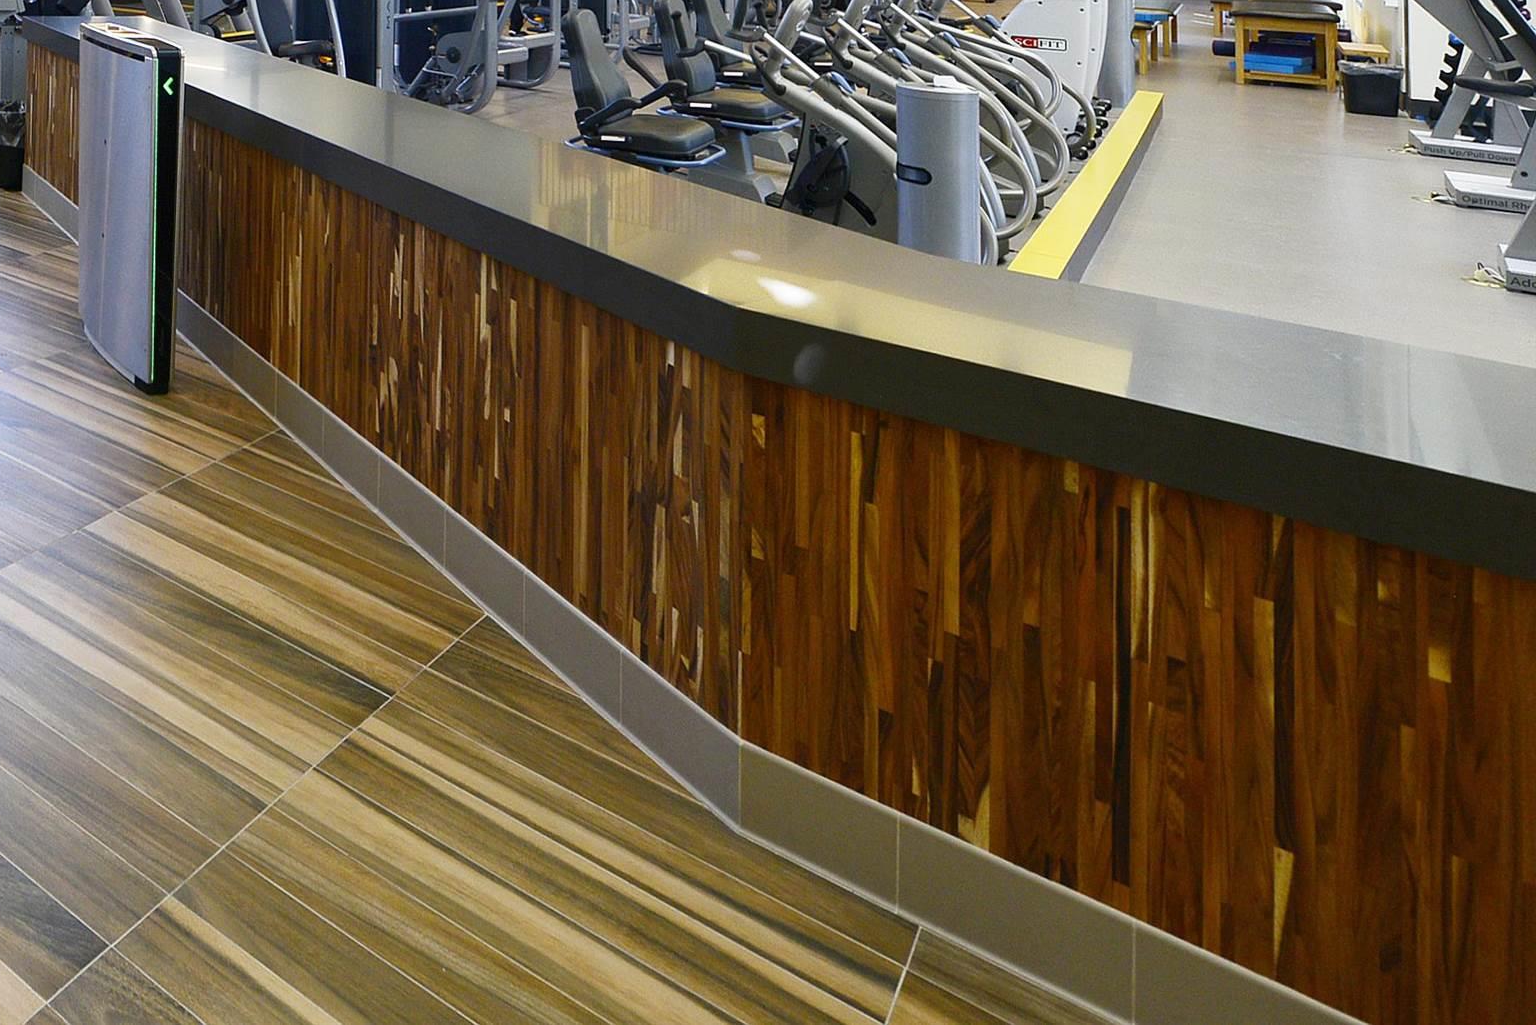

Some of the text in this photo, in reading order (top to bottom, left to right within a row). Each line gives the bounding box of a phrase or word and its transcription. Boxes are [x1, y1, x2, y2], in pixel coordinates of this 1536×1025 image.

[1014, 38, 1065, 48] SCIFIT
[1424, 147, 1516, 162] Push Up/Pull Down
[1462, 195, 1509, 209] Optimal
